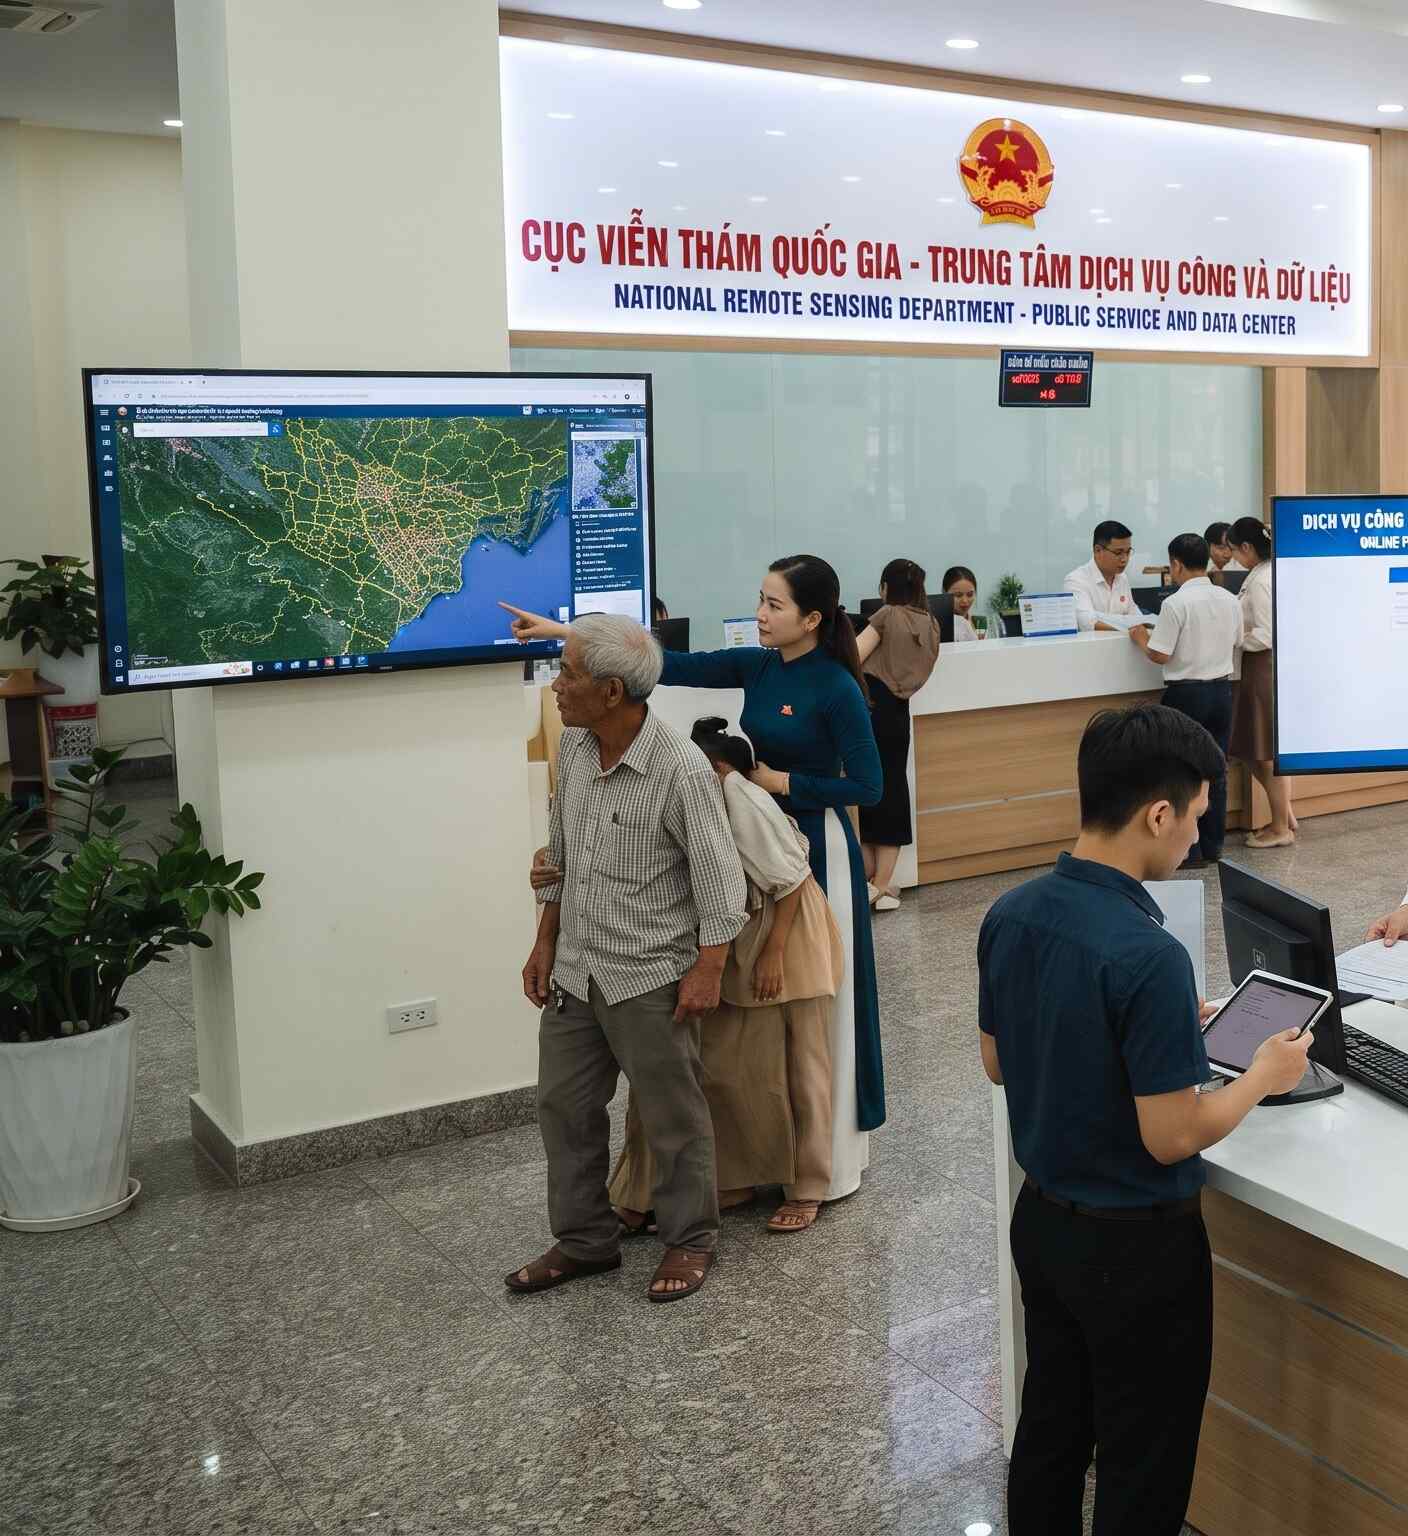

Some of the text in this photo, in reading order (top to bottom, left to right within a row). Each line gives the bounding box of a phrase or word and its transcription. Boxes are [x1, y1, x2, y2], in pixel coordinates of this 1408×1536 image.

[521, 219, 586, 273] CỤC
[597, 208, 668, 267] VIỄN
[678, 222, 762, 273] THÁM
[772, 222, 847, 279] QUỐC
[857, 240, 902, 280] GIA
[928, 245, 1012, 286] TRUNG
[1020, 244, 1072, 289] TÂM
[1080, 255, 1134, 298] DỊCH
[1142, 261, 1170, 302] VỤ
[1177, 256, 1237, 298] CÔNG
[1243, 258, 1270, 300] VÀ
[1277, 261, 1305, 302] DỮ
[1309, 264, 1351, 312] LIỆU
[614, 283, 717, 312] NATIONAL
[723, 288, 803, 316] REMOTE
[810, 292, 893, 320] SENSING
[899, 297, 1015, 324] DEPARTMENT
[1032, 306, 1091, 328] PUBLIC
[1096, 307, 1161, 331] SERVICE
[1166, 310, 1198, 332] AND
[1202, 312, 1238, 335] DATA
[1242, 314, 1297, 336] CENTER
[1340, 513, 1361, 534] VỤ
[1364, 508, 1404, 529] CÔNG
[1359, 535, 1400, 549] ONLINE
